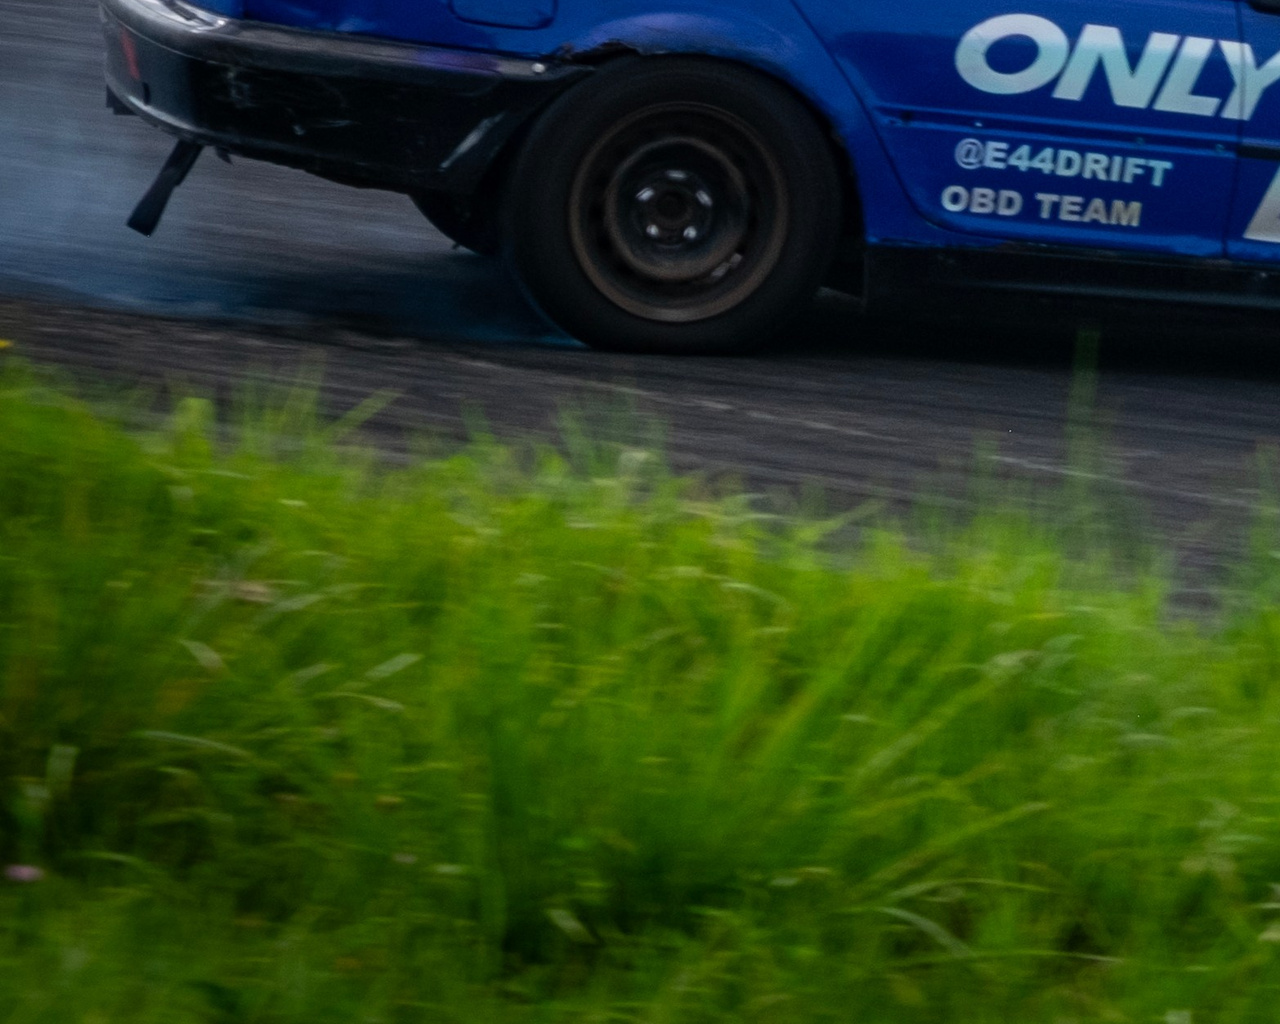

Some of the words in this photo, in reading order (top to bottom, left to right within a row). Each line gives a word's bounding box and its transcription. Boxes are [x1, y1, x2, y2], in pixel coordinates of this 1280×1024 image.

[953, 137, 1174, 188] @E44DRIFT
[940, 184, 1024, 217] OBD
[1034, 191, 1143, 228] TEAM
